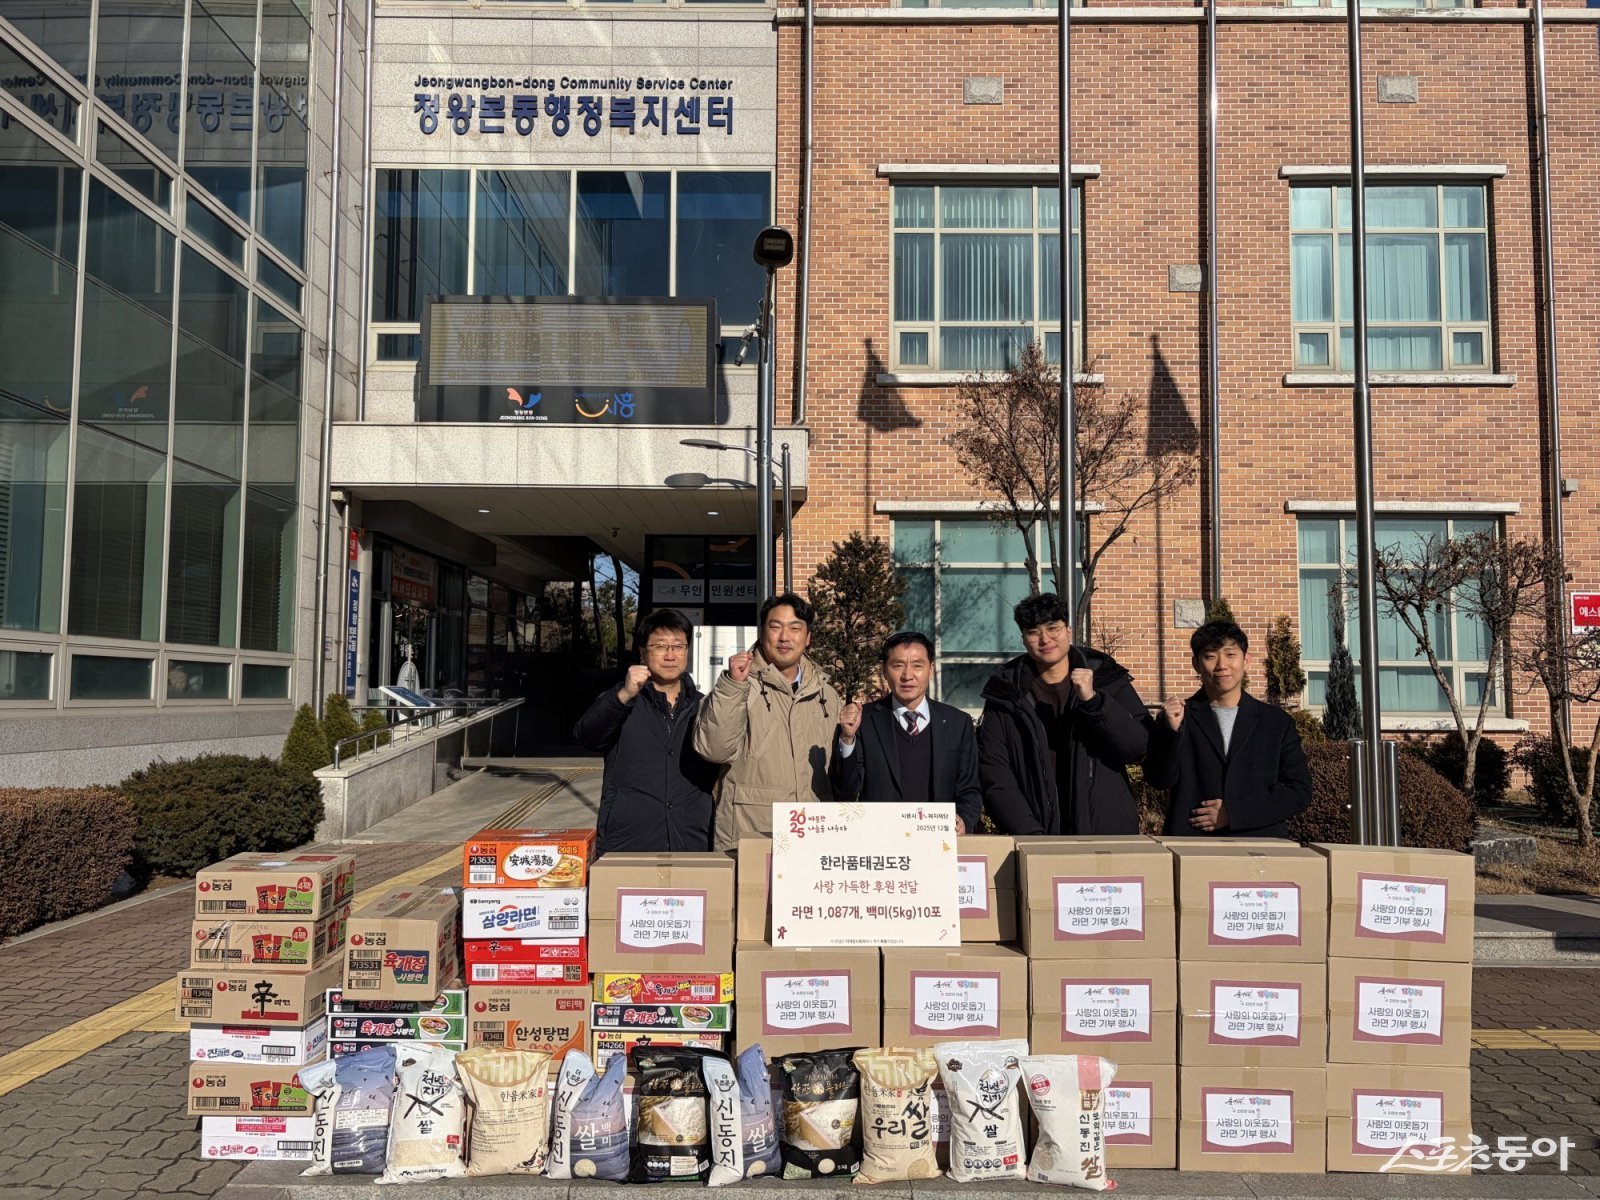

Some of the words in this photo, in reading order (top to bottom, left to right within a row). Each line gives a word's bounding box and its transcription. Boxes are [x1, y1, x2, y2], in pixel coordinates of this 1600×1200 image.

[414, 75, 555, 90] Jeongwangbon-dong
[560, 77, 632, 91] Community
[636, 78, 685, 90] Service
[690, 78, 733, 90] Center
[413, 92, 733, 136] 정왕본동행정복지센터
[681, 585, 702, 596] 무인
[711, 585, 757, 597] 민원센터
[480, 846, 497, 854] 농심
[470, 856, 496, 865] 가3632
[820, 855, 911, 871] 한라품태권도장
[212, 882, 233, 891] 농심
[813, 880, 835, 894] 사랑
[838, 880, 870, 894] 가득한
[873, 880, 895, 894] 후원
[897, 880, 919, 894] 전달
[791, 905, 814, 920] 라면
[818, 906, 863, 920] 1,087개,
[866, 905, 942, 920] 백미(5kg)10포
[1068, 906, 1093, 916] 사랑의
[1095, 906, 1130, 916] 이웃돕기
[1370, 903, 1396, 914] 사랑의
[1398, 905, 1433, 917] 이웃돕기
[482, 905, 537, 930] 삼양라면
[1223, 911, 1249, 921] 사랑의
[1251, 911, 1286, 921] 이웃돕기
[1374, 915, 1391, 925] 라면
[1393, 916, 1411, 926] 기부
[1412, 917, 1430, 927] 행사
[630, 919, 655, 929] 사랑의
[658, 919, 691, 929] 이웃돕기
[1071, 917, 1089, 927] 라면
[1091, 917, 1109, 927] 기부
[1110, 917, 1128, 927] 행사
[1227, 922, 1245, 931] 라면
[1247, 922, 1265, 931] 기부
[1266, 922, 1284, 931] 행사
[634, 930, 651, 940] 라면
[654, 930, 670, 940] 기부
[672, 930, 689, 940] 행사
[364, 936, 386, 946] 농심
[352, 961, 379, 969] 가3531
[383, 951, 427, 972] 육개장
[397, 972, 424, 982] 사발면
[228, 983, 247, 992] 농심
[251, 979, 279, 1018] 辛
[776, 1000, 800, 1009] 사랑의
[803, 999, 837, 1009] 이웃돕기
[488, 1002, 510, 1012] 농심
[924, 1001, 949, 1011] 사랑의
[952, 1001, 986, 1011] 이웃돕기
[623, 1008, 658, 1024] 육개장
[656, 1016, 678, 1024] 사발면
[780, 1011, 797, 1020] 라면
[799, 1011, 816, 1020] 기부
[818, 1010, 835, 1020] 행사
[928, 1012, 945, 1022] 라면
[948, 1012, 964, 1022] 기부
[966, 1012, 984, 1022] 행사
[1075, 1008, 1100, 1018] 사랑의
[1103, 1008, 1137, 1018] 이웃돕기
[1224, 1010, 1250, 1020] 사랑의
[1252, 1011, 1287, 1021] 이웃돕기
[1368, 1007, 1393, 1017] 사랑의
[1395, 1008, 1430, 1018] 이웃돕기
[360, 1020, 396, 1036] 육개장
[393, 1028, 416, 1036] 사발면
[1079, 1019, 1097, 1028] 라면
[1098, 1019, 1116, 1028] 기부
[1118, 1019, 1135, 1028] 행사
[1228, 1021, 1245, 1031] 라면
[1247, 1022, 1265, 1031] 기부
[1266, 1022, 1284, 1032] 행사
[1371, 1018, 1389, 1028] 라면
[1391, 1018, 1408, 1029] 기부
[1410, 1020, 1427, 1030] 행사
[515, 1027, 570, 1042] 안성탕면
[206, 1078, 226, 1087] 농심
[422, 1070, 444, 1084] 천년
[423, 1086, 444, 1095] 지기
[979, 1079, 1000, 1091] 천년
[982, 1093, 1001, 1103] 지기
[314, 1089, 335, 1163] 신동진
[417, 1119, 435, 1134] 쌀
[551, 1090, 573, 1165] 신동진
[1118, 1120, 1136, 1130] 행사
[1216, 1118, 1242, 1128] 사랑의
[1244, 1119, 1279, 1128] 이웃돕기
[1366, 1119, 1392, 1130] 사랑의
[1394, 1120, 1429, 1131] 이웃돕기
[574, 1122, 600, 1151] 쌀
[601, 1121, 612, 1147] 백미
[983, 1124, 999, 1139] 쌀
[1079, 1113, 1091, 1153] 신동진
[1220, 1129, 1237, 1138] 라면
[1240, 1129, 1257, 1139] 기부
[1259, 1129, 1277, 1139] 행사
[1370, 1130, 1388, 1140] 라면
[1390, 1131, 1408, 1141] 기부
[747, 1123, 768, 1153] 쌀
[1081, 1155, 1103, 1181] 쌀
